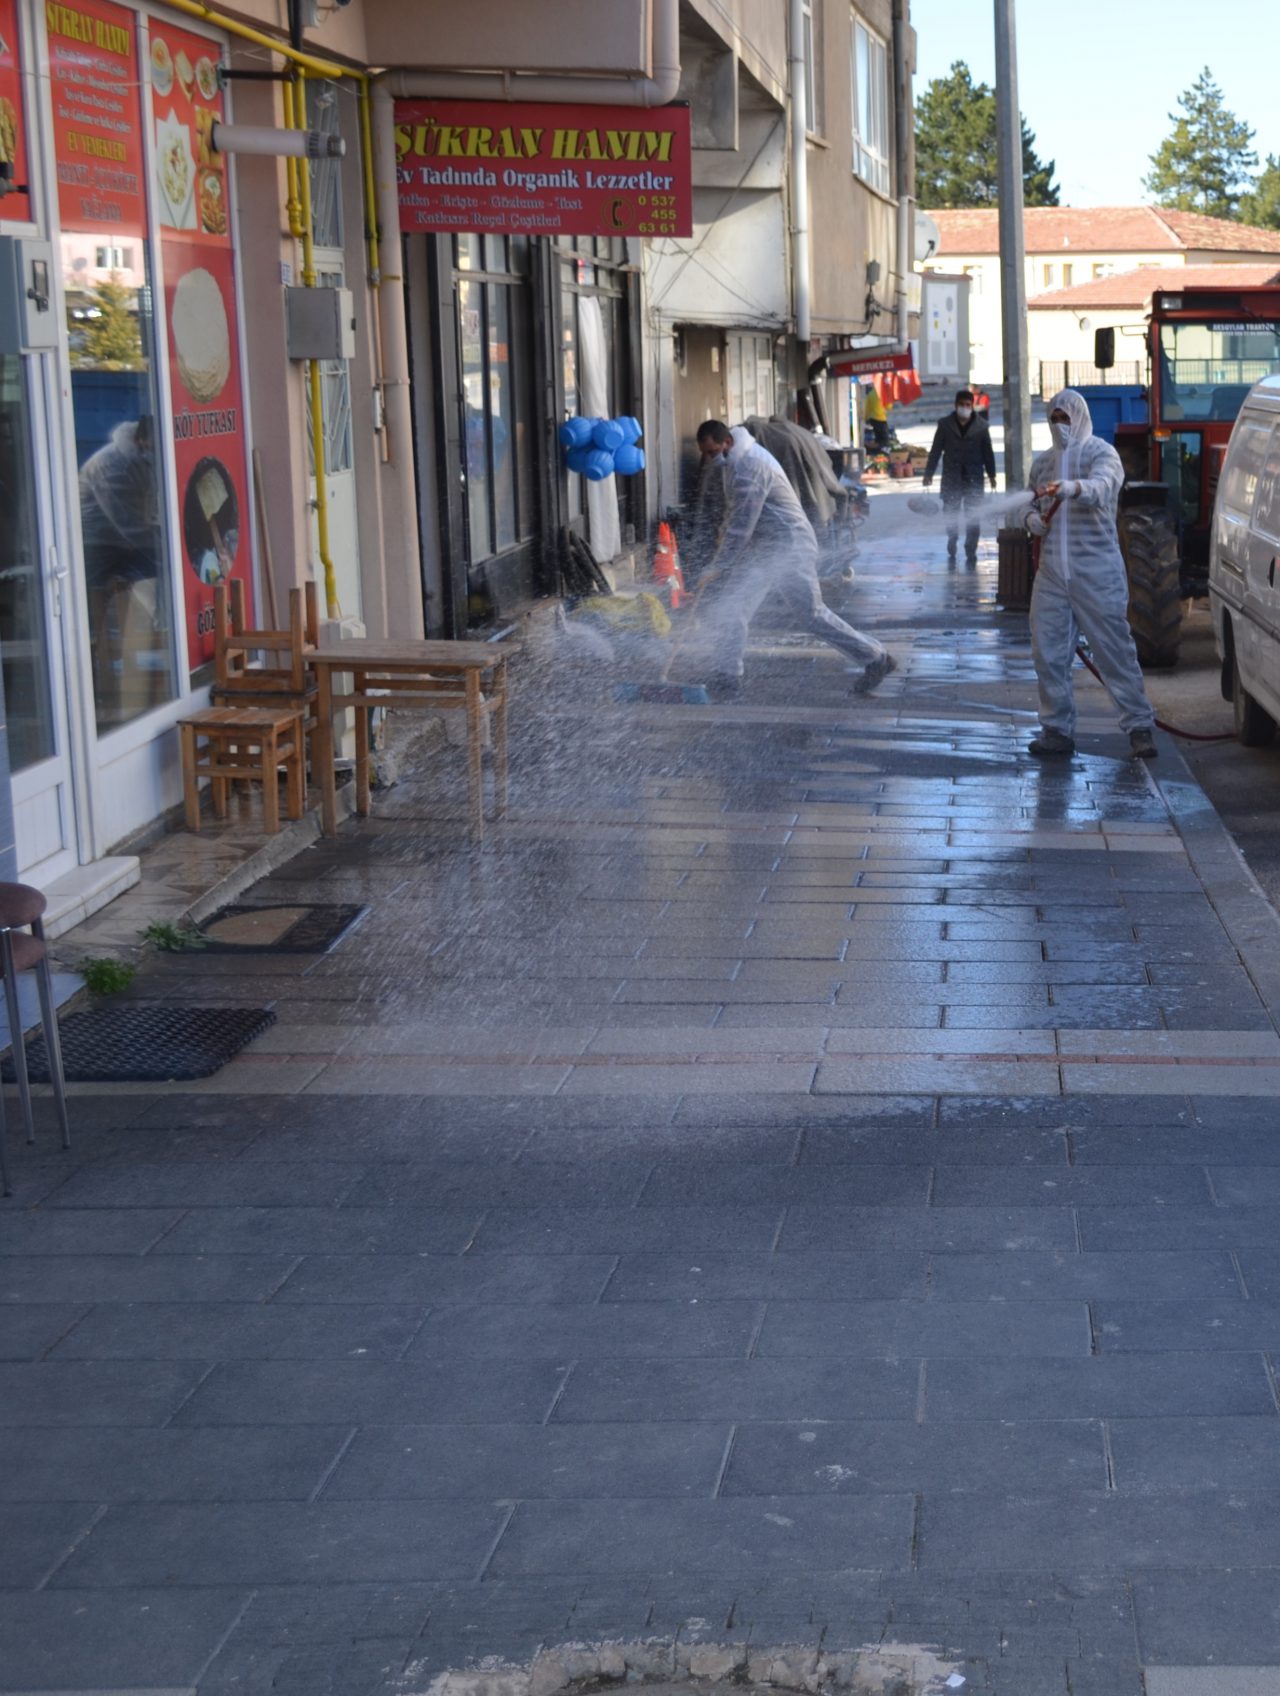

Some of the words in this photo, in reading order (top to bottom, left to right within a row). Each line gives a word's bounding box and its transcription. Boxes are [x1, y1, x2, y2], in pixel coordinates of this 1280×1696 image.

[395, 117, 545, 162] ŞÜKRAN
[551, 128, 674, 161] HANIM
[420, 166, 497, 187] Tadında
[503, 168, 580, 193] Organik
[585, 170, 673, 191] Lezzetler
[638, 195, 646, 206] 0
[651, 196, 676, 206] 537
[651, 209, 677, 219] 455
[638, 223, 655, 233] 63
[660, 223, 676, 233] 61
